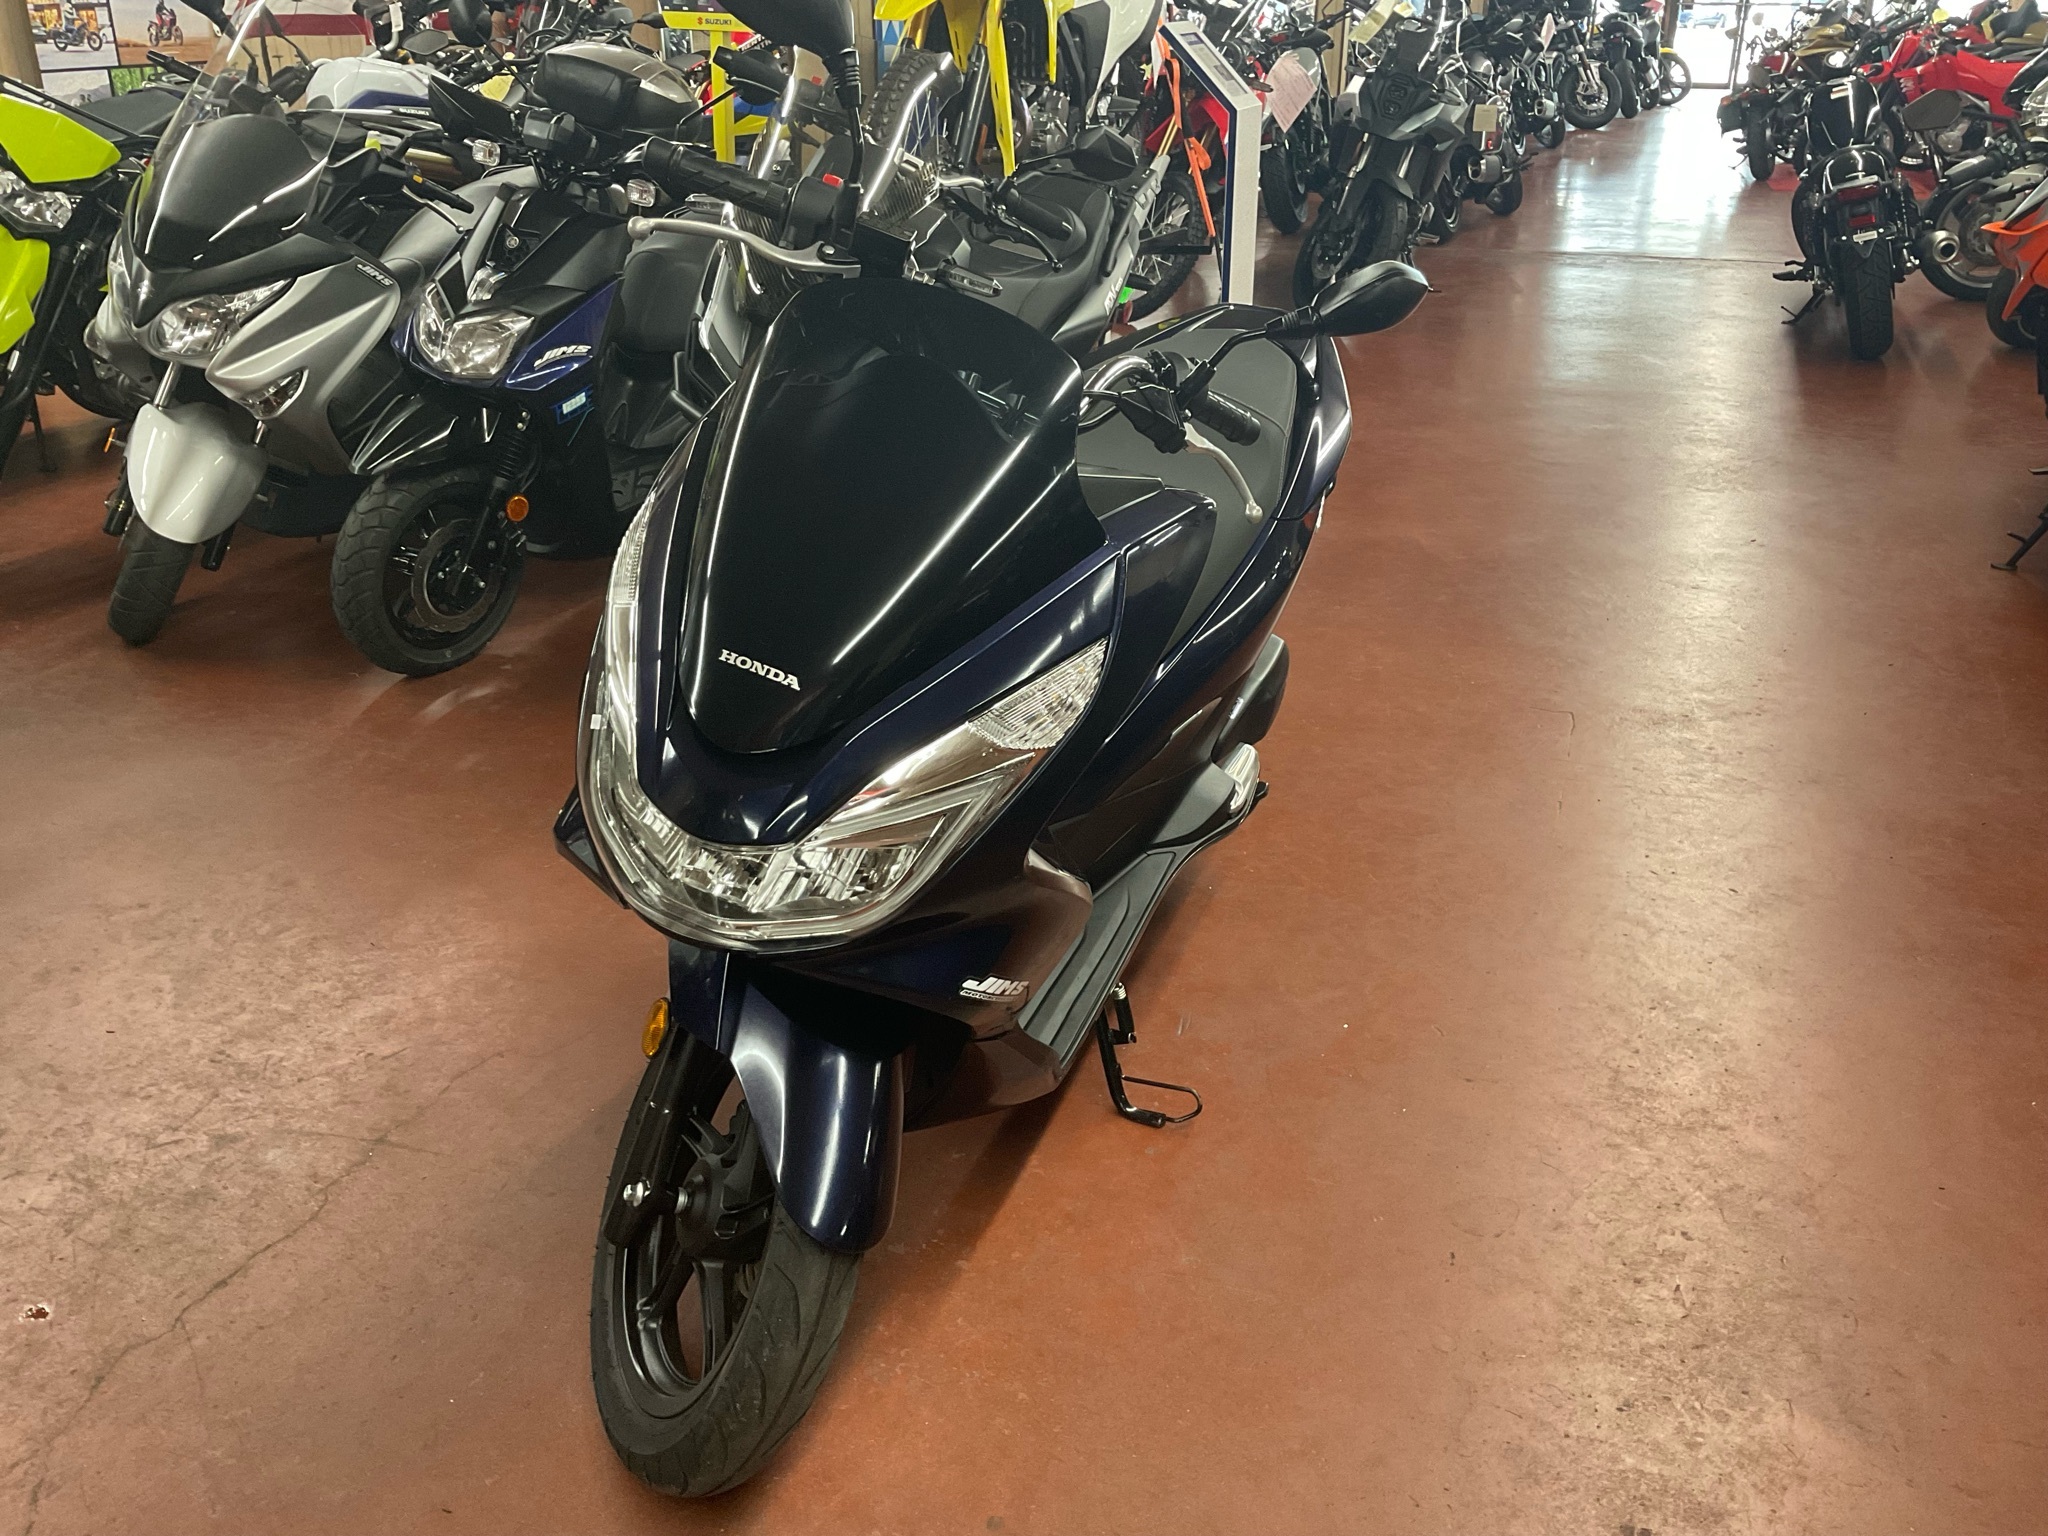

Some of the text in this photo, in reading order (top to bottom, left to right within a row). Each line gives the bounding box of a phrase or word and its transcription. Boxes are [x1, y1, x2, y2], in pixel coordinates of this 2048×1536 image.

[356, 263, 394, 286] JIMS
[533, 344, 592, 367] JIMS
[718, 648, 801, 692] HONDA
[961, 976, 1030, 996] JIMS
